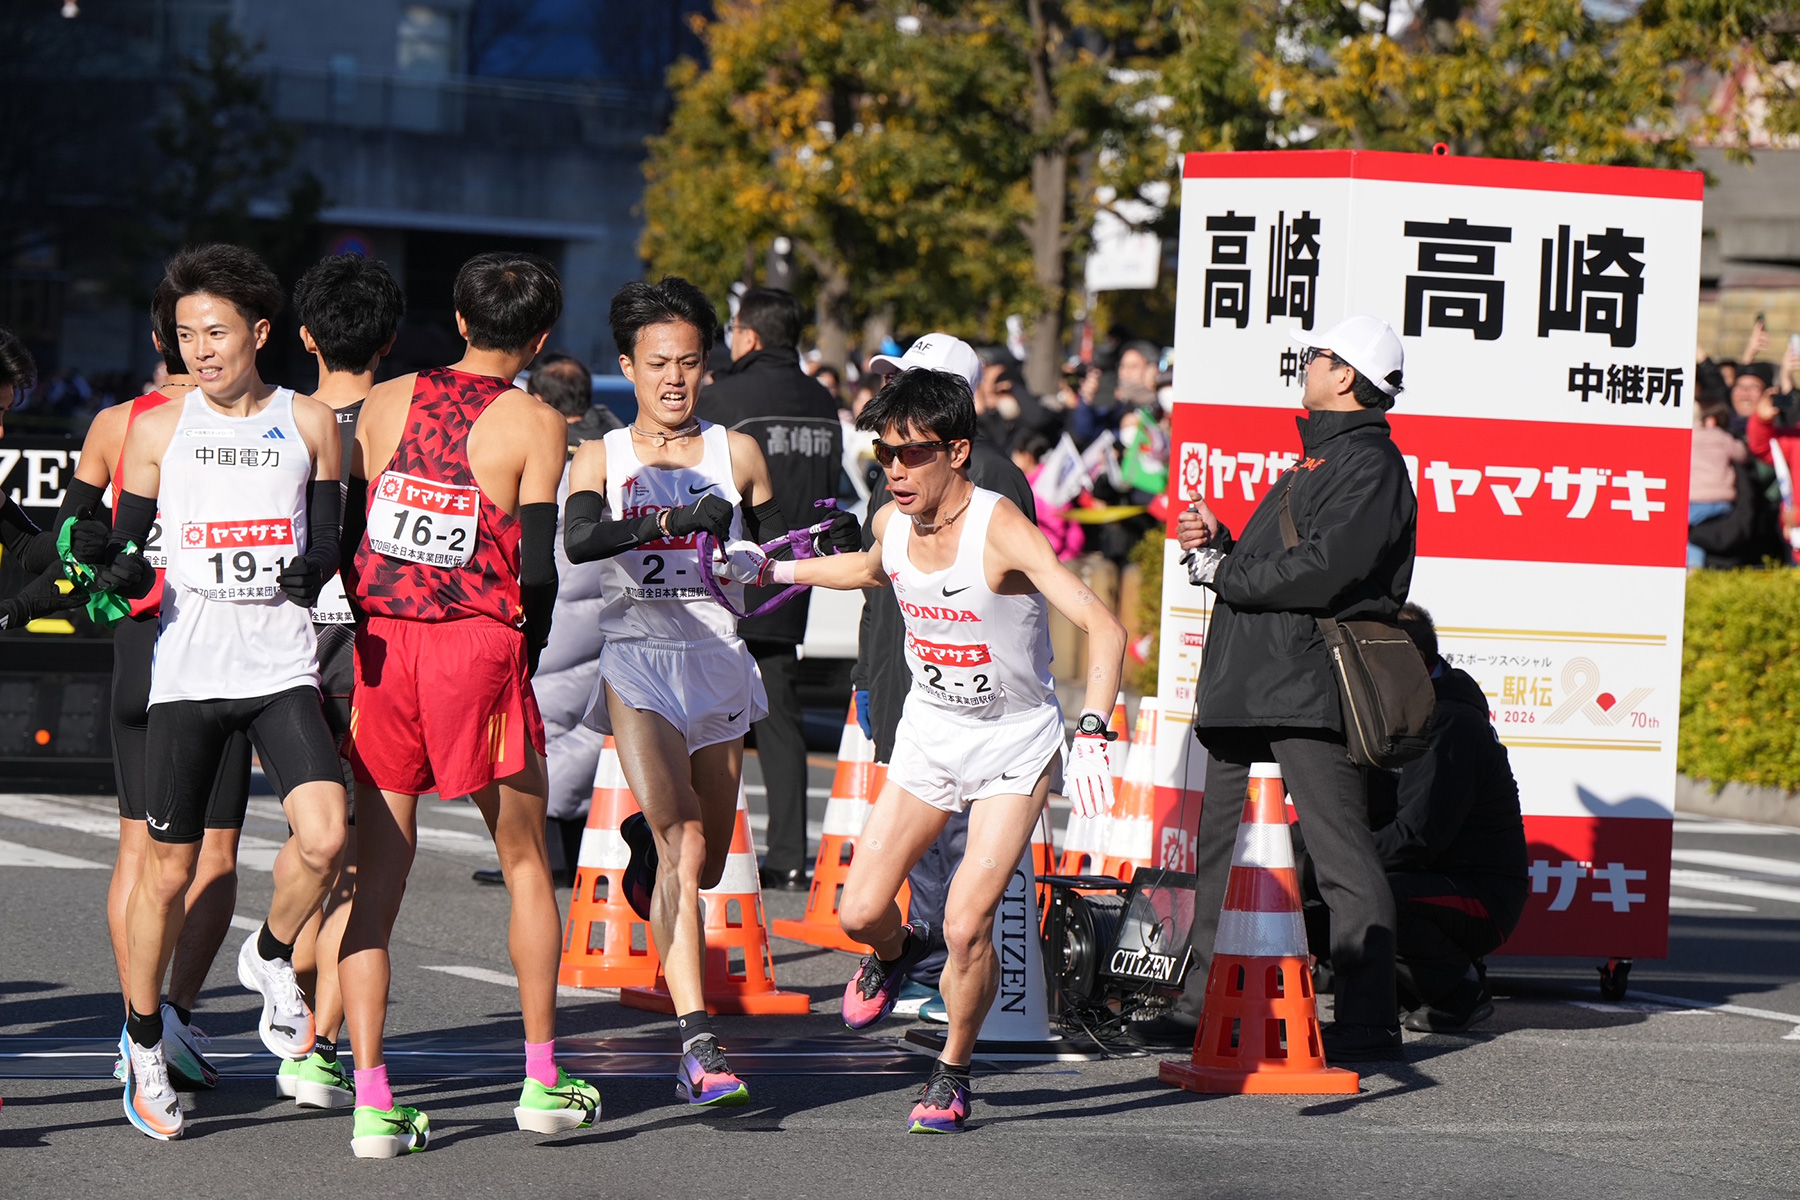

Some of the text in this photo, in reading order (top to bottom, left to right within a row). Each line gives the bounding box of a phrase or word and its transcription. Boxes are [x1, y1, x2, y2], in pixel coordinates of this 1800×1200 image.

[1203, 210, 1321, 331] 高崎
[1403, 217, 1646, 348] 高崎
[1568, 362, 1684, 407] 中継所
[766, 425, 833, 457] 高崎市
[195, 446, 280, 468] 中国電力
[406, 485, 470, 510] ヤマザキ
[1424, 461, 1667, 521] ヤマザキ
[211, 524, 288, 543] ヤマザキ
[394, 509, 466, 552] 16-2
[916, 643, 984, 663] ヤマザキ
[1439, 653, 1552, 668] 春スポーツスペシャル
[1479, 676, 1553, 707] ー駅伝
[1505, 711, 1536, 723] 2026
[1630, 712, 1660, 728] 70th
[1001, 870, 1026, 1015] CITIZEN
[1110, 949, 1176, 981] CITIZEN
